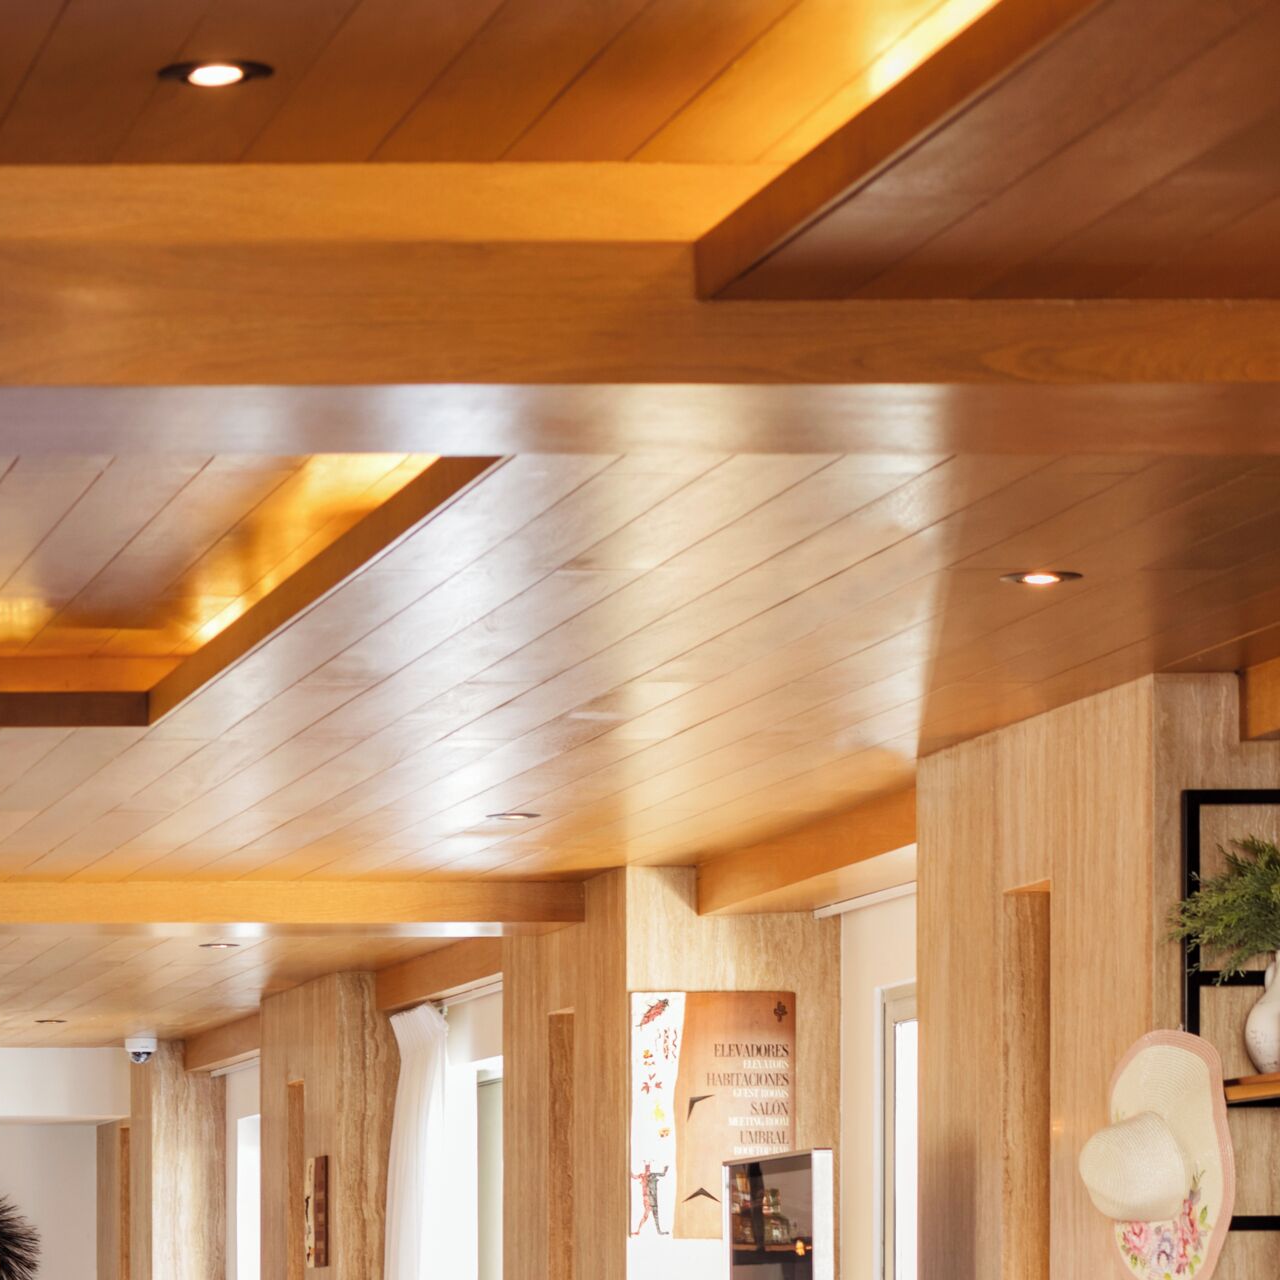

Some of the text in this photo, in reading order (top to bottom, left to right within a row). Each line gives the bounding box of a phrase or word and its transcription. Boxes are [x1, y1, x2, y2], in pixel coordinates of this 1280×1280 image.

[714, 1044, 789, 1058] ELEVADORES
[706, 1072, 789, 1086] HABITACIONES
[750, 1100, 788, 1116] SALÓN
[740, 1130, 789, 1144] UMBRAL
